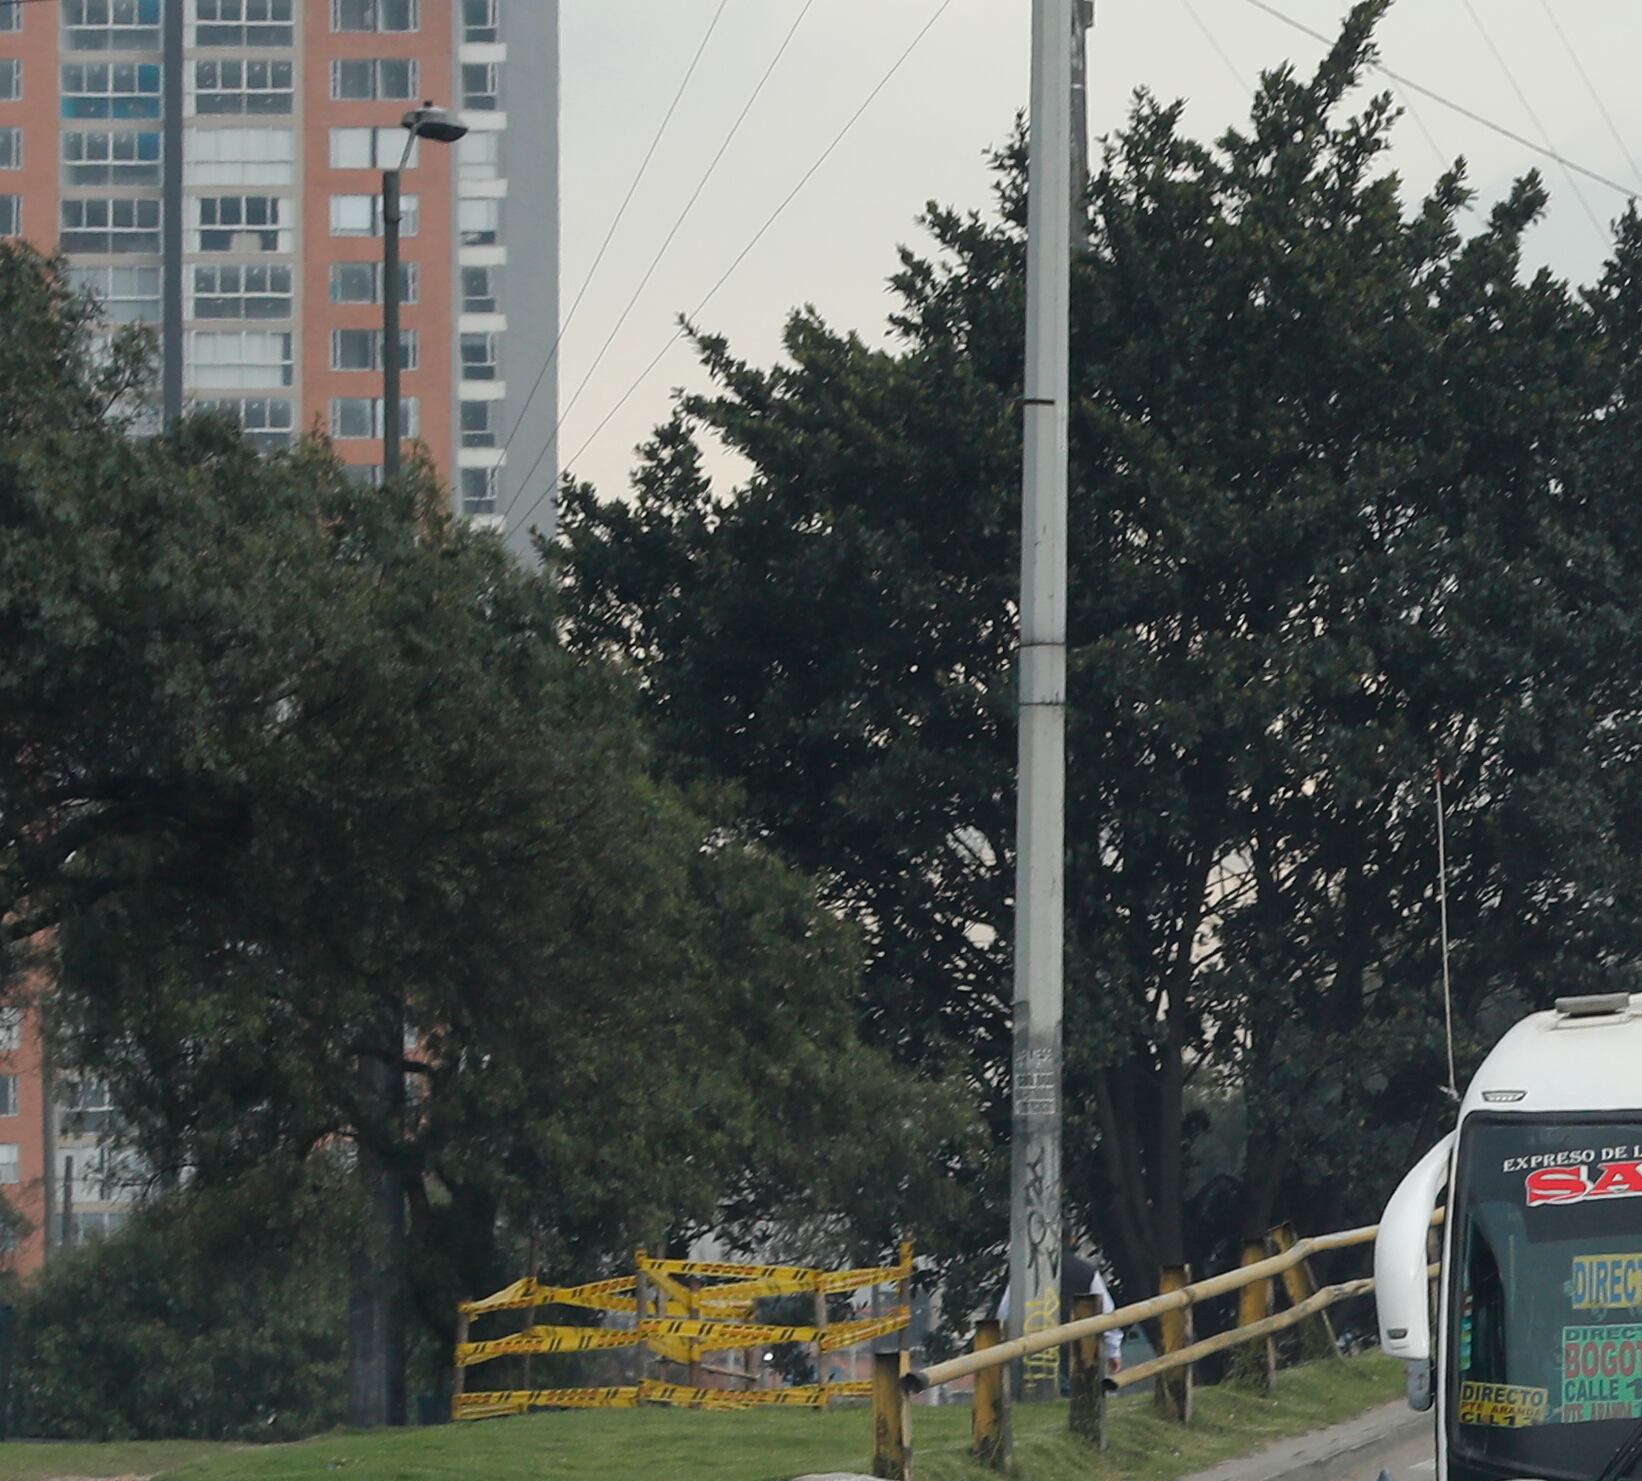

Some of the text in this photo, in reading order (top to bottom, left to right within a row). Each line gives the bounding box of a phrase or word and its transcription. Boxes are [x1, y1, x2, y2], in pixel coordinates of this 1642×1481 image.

[1502, 1147, 1597, 1173] EXPRESO
[1600, 1146, 1629, 1161] DE
[1461, 1384, 1544, 1408] DIRECTO
[1564, 1378, 1619, 1402] CALLE
